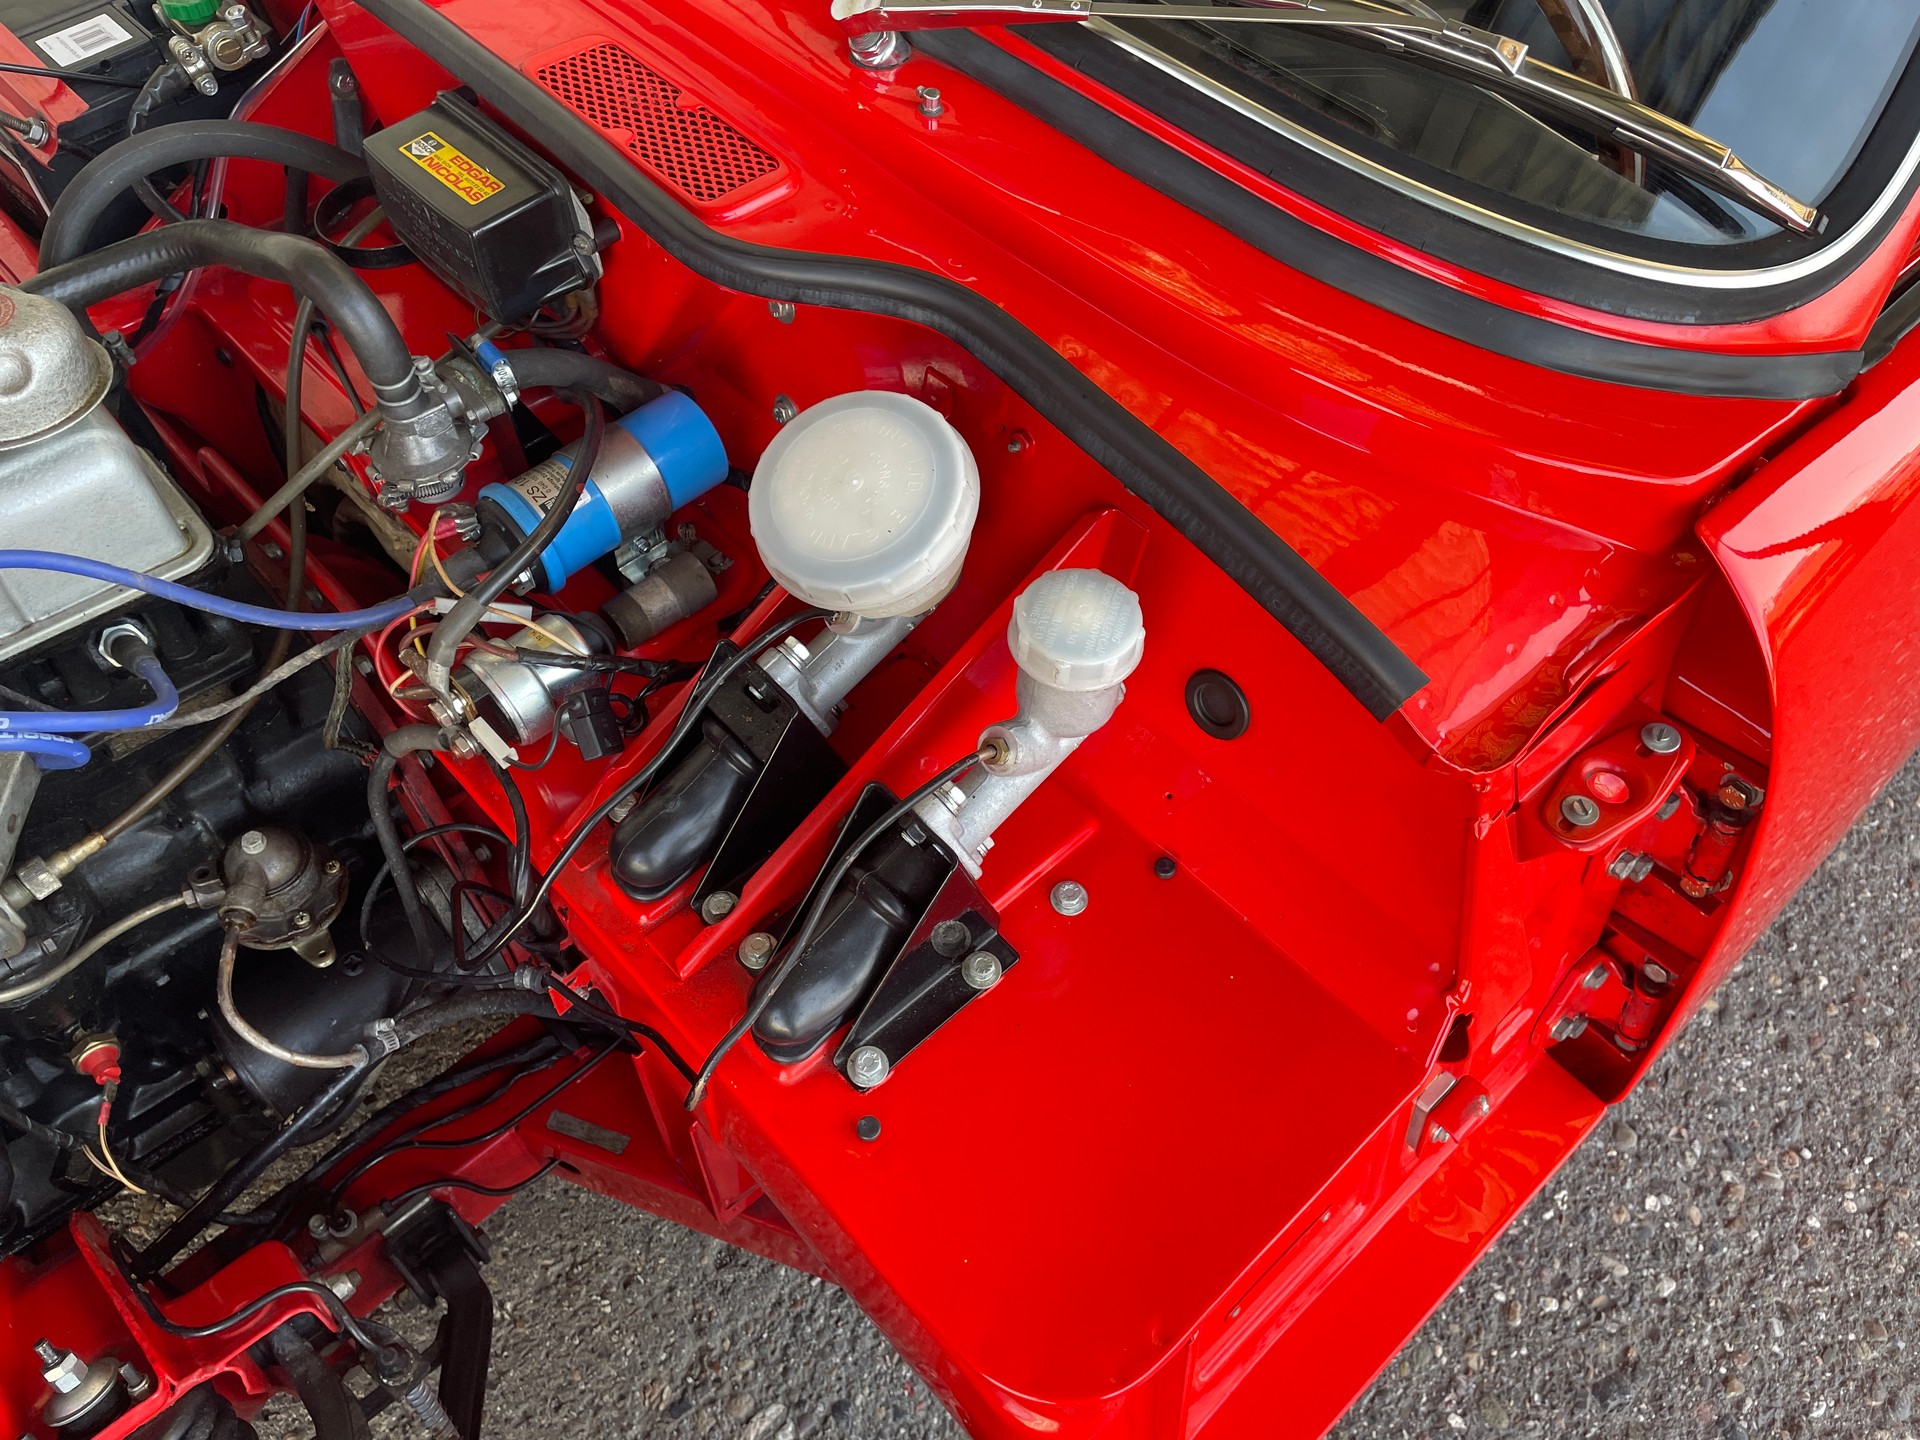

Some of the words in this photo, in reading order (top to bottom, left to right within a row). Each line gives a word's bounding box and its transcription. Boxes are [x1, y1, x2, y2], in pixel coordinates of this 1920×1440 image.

[422, 156, 485, 203] NICOLAS
[449, 154, 502, 192] EDGAR
[526, 485, 547, 502] ZS
